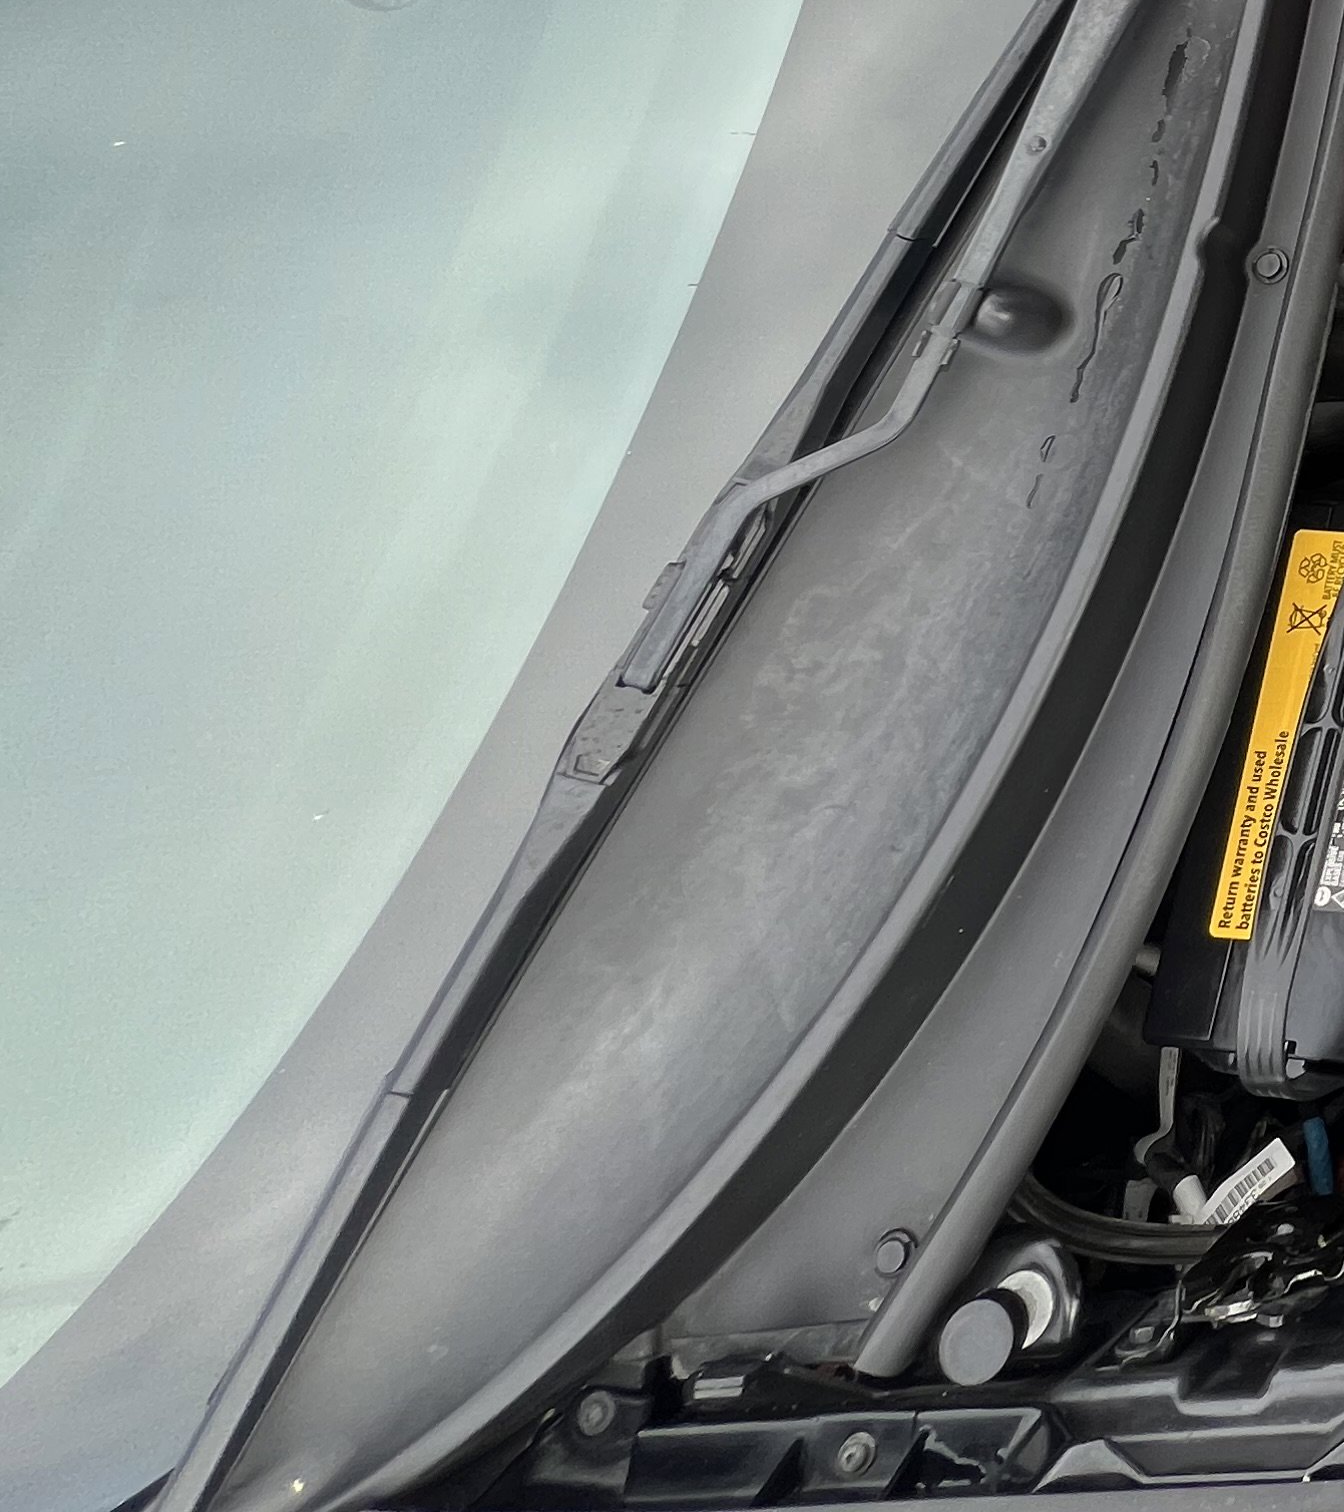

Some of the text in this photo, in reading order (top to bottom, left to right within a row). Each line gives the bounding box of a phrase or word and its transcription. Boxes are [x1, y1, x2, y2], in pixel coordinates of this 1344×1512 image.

[1322, 567, 1338, 599] BATTERY
[1218, 750, 1266, 928] Return warranty and used
[1235, 731, 1288, 929] batteries to Costco Wholesale
